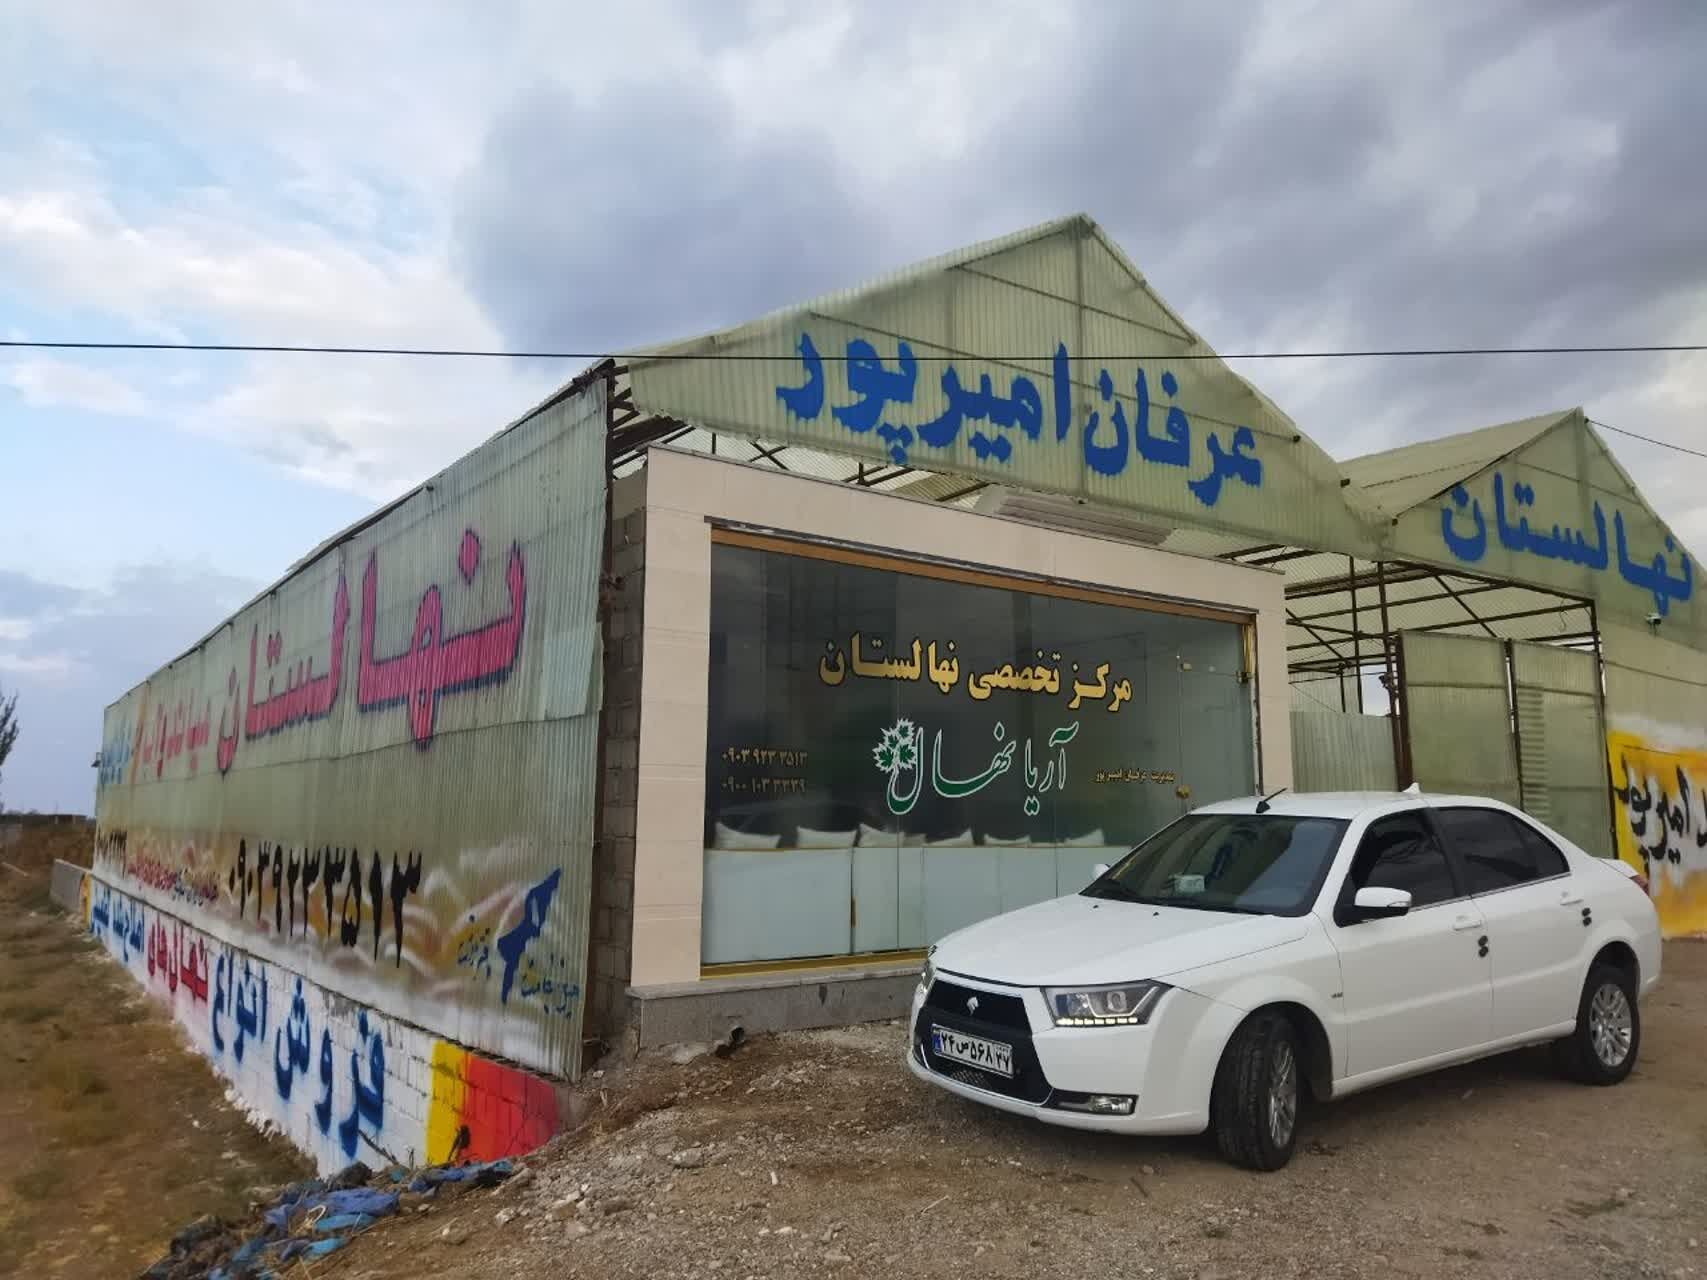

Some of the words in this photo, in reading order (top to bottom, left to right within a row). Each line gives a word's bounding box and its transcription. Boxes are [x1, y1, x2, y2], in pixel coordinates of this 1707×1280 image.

[776, 332, 1070, 464] امیرپور
[1084, 367, 1262, 507] عرفان
[1441, 471, 1693, 617] نهالستان
[217, 528, 527, 777] نهالستان
[818, 632, 960, 694] نهالستان
[966, 649, 1061, 702] تخصصی
[1068, 662, 1134, 711] مرکز
[886, 720, 1017, 816] نهال
[1024, 720, 1080, 816] آریا
[212, 950, 268, 1064] انواع
[274, 975, 385, 1161] فروش
